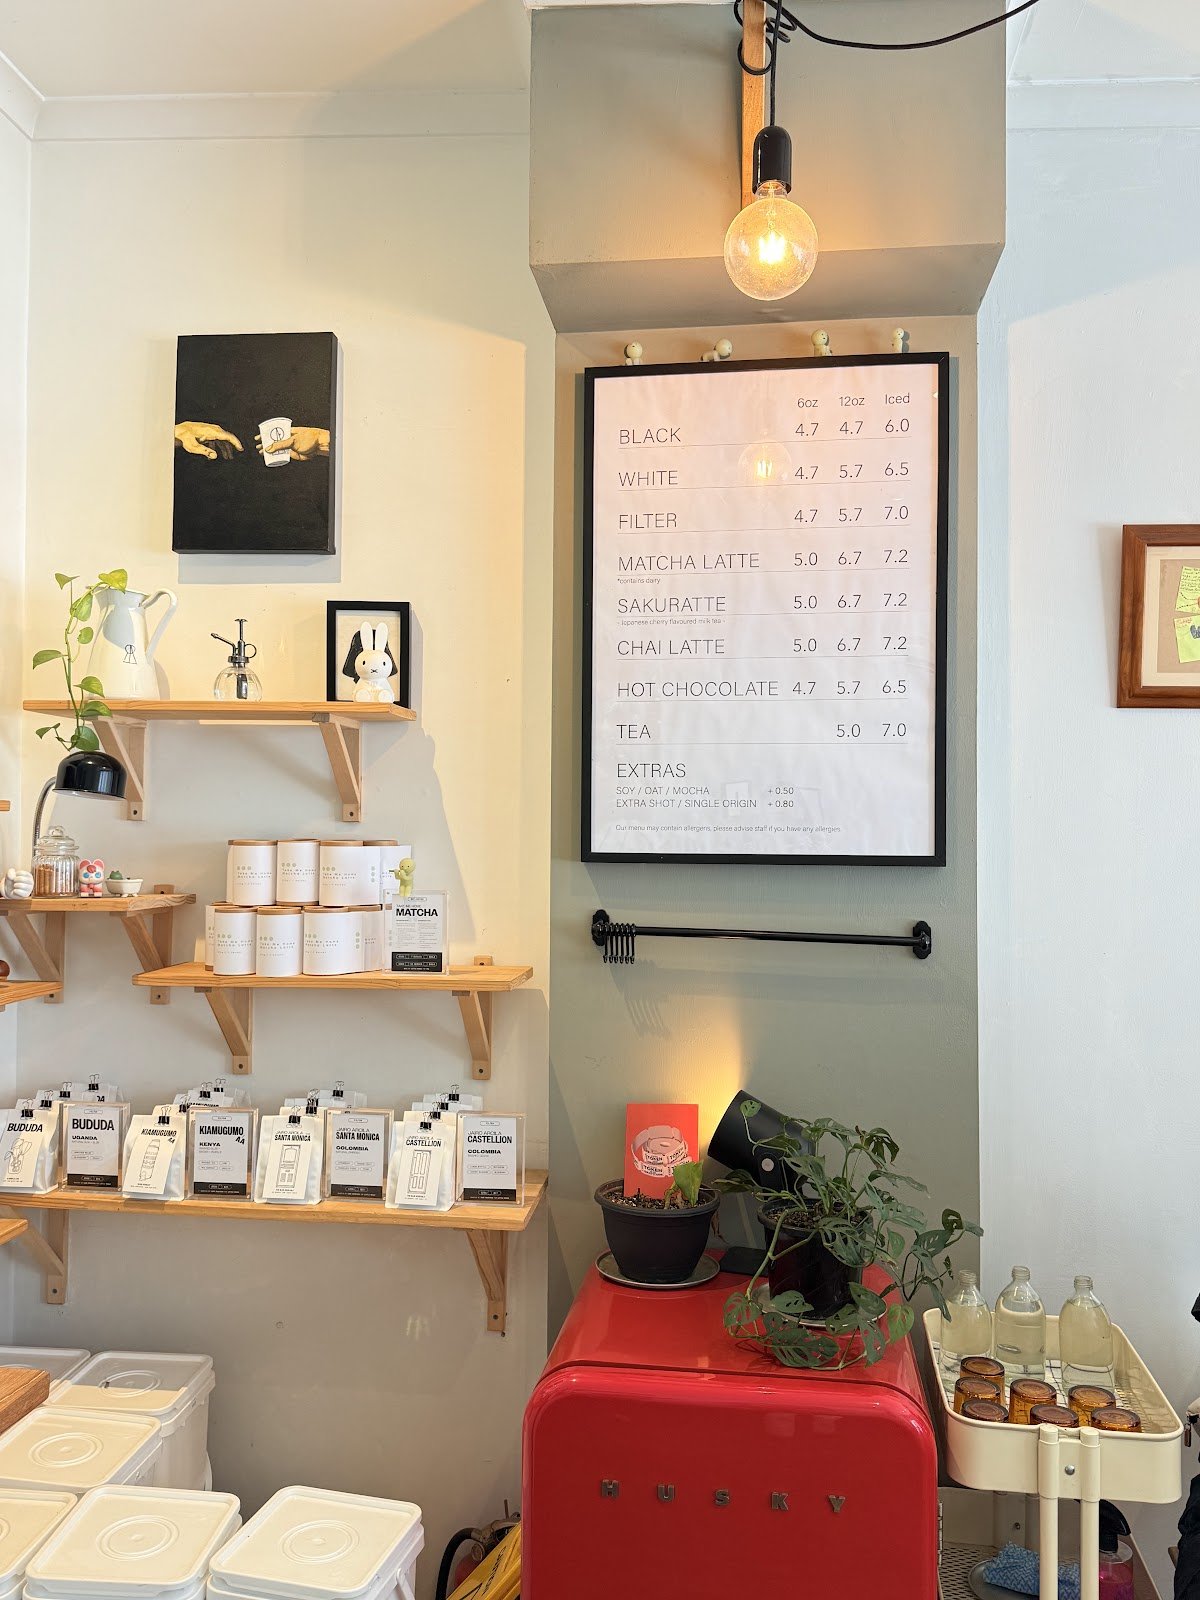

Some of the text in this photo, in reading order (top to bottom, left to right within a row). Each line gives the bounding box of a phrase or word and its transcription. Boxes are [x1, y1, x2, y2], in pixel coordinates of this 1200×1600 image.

[798, 393, 910, 408] 6oz 12oz Iced
[619, 419, 910, 444] BLACK 4.7 4.7 6.0
[619, 462, 909, 487] WHITE 4.7 5.7 6.5
[619, 506, 908, 529] FILTER 4.7 5.7 7.0
[618, 550, 908, 571] MATCHA LATTE 5.0 6.7 7.2
[618, 593, 907, 613] SAKURATTE 5.0 6.7 7.2
[617, 636, 907, 655] CHAI LATTE 5.0 6.7 7.2
[617, 680, 907, 697] HOT CHOCOLATE 4.7 5.7 6.5
[616, 723, 907, 739] TEA 5.0 7.0
[616, 763, 686, 778] EXTRAS
[616, 786, 635, 795] SOY
[644, 786, 663, 795] OAT
[673, 786, 710, 795] MOCHA
[775, 786, 794, 795] 0.50
[616, 799, 647, 808] EXTRA
[649, 799, 676, 808] SHOT
[684, 799, 720, 808] SINGLE
[722, 799, 757, 808] ORIGIN
[775, 799, 794, 808] 0.80
[7, 1123, 43, 1132] BUDUDA
[72, 1118, 114, 1130] BUDUDA
[200, 1126, 244, 1135] KIAMUGUMO
[141, 1128, 177, 1137] KIAMUGUMO
[236, 1136, 245, 1144] AA
[336, 1132, 380, 1141] SANTA MONICA
[601, 1479, 846, 1514] HUSKY
